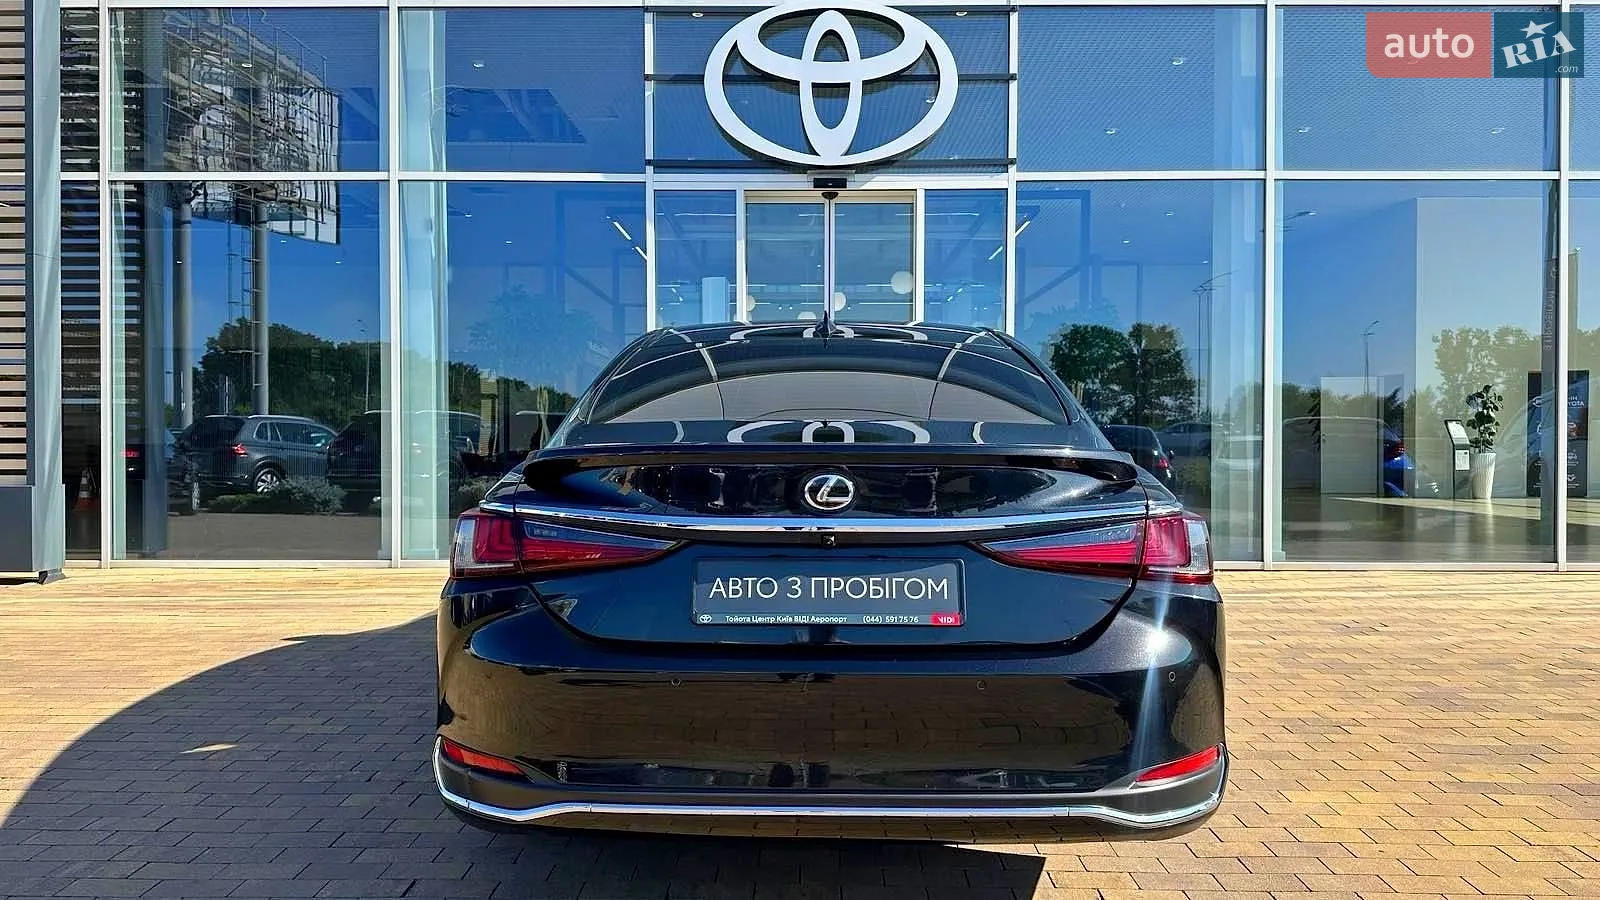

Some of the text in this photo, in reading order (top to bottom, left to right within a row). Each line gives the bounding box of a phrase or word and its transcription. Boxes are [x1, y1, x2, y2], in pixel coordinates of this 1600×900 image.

[708, 577, 948, 600] АВТО З ПРОБІГОМ
[725, 615, 848, 624] Тойота Центр Київ ВІДІ Аеропорт
[863, 615, 883, 624] (044)
